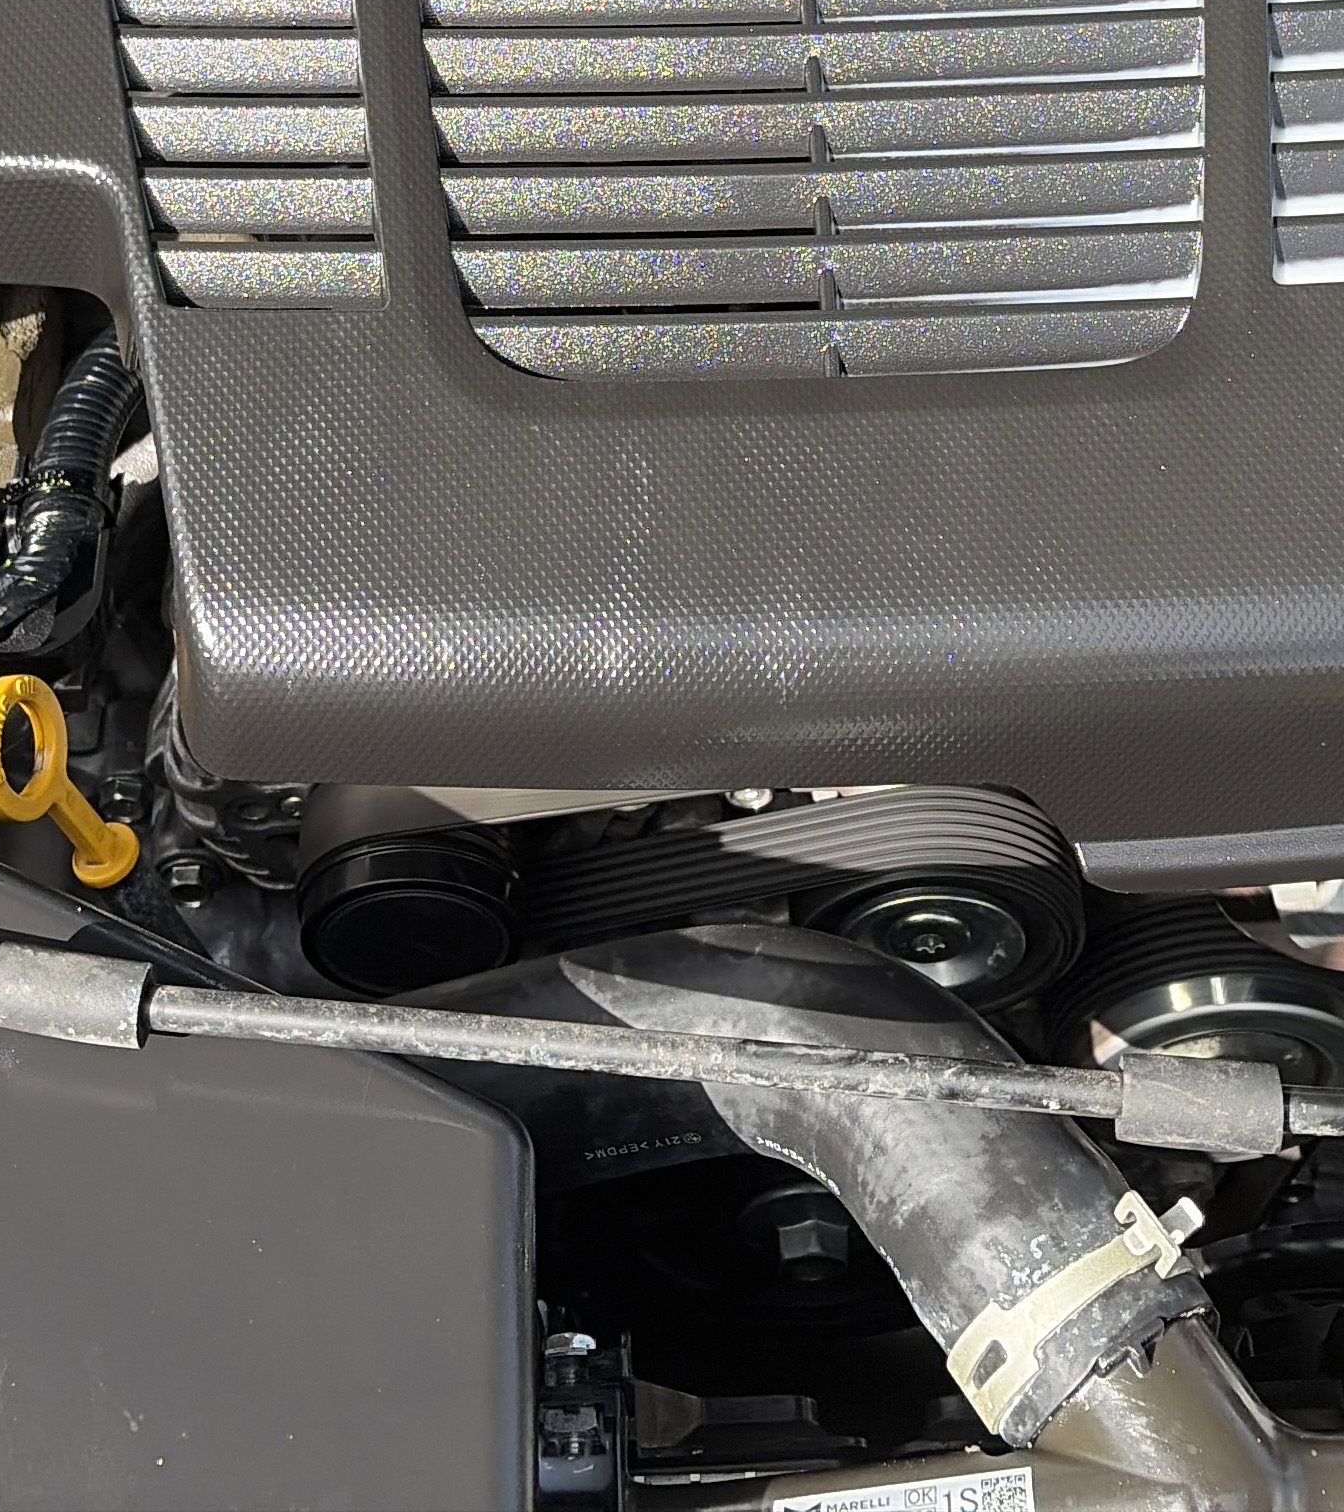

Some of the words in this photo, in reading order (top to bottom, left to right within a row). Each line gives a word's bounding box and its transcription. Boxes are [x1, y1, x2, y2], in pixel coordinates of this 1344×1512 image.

[16, 674, 37, 696] OIL
[827, 1497, 890, 1512] MARELLI
[908, 1486, 934, 1504] OK
